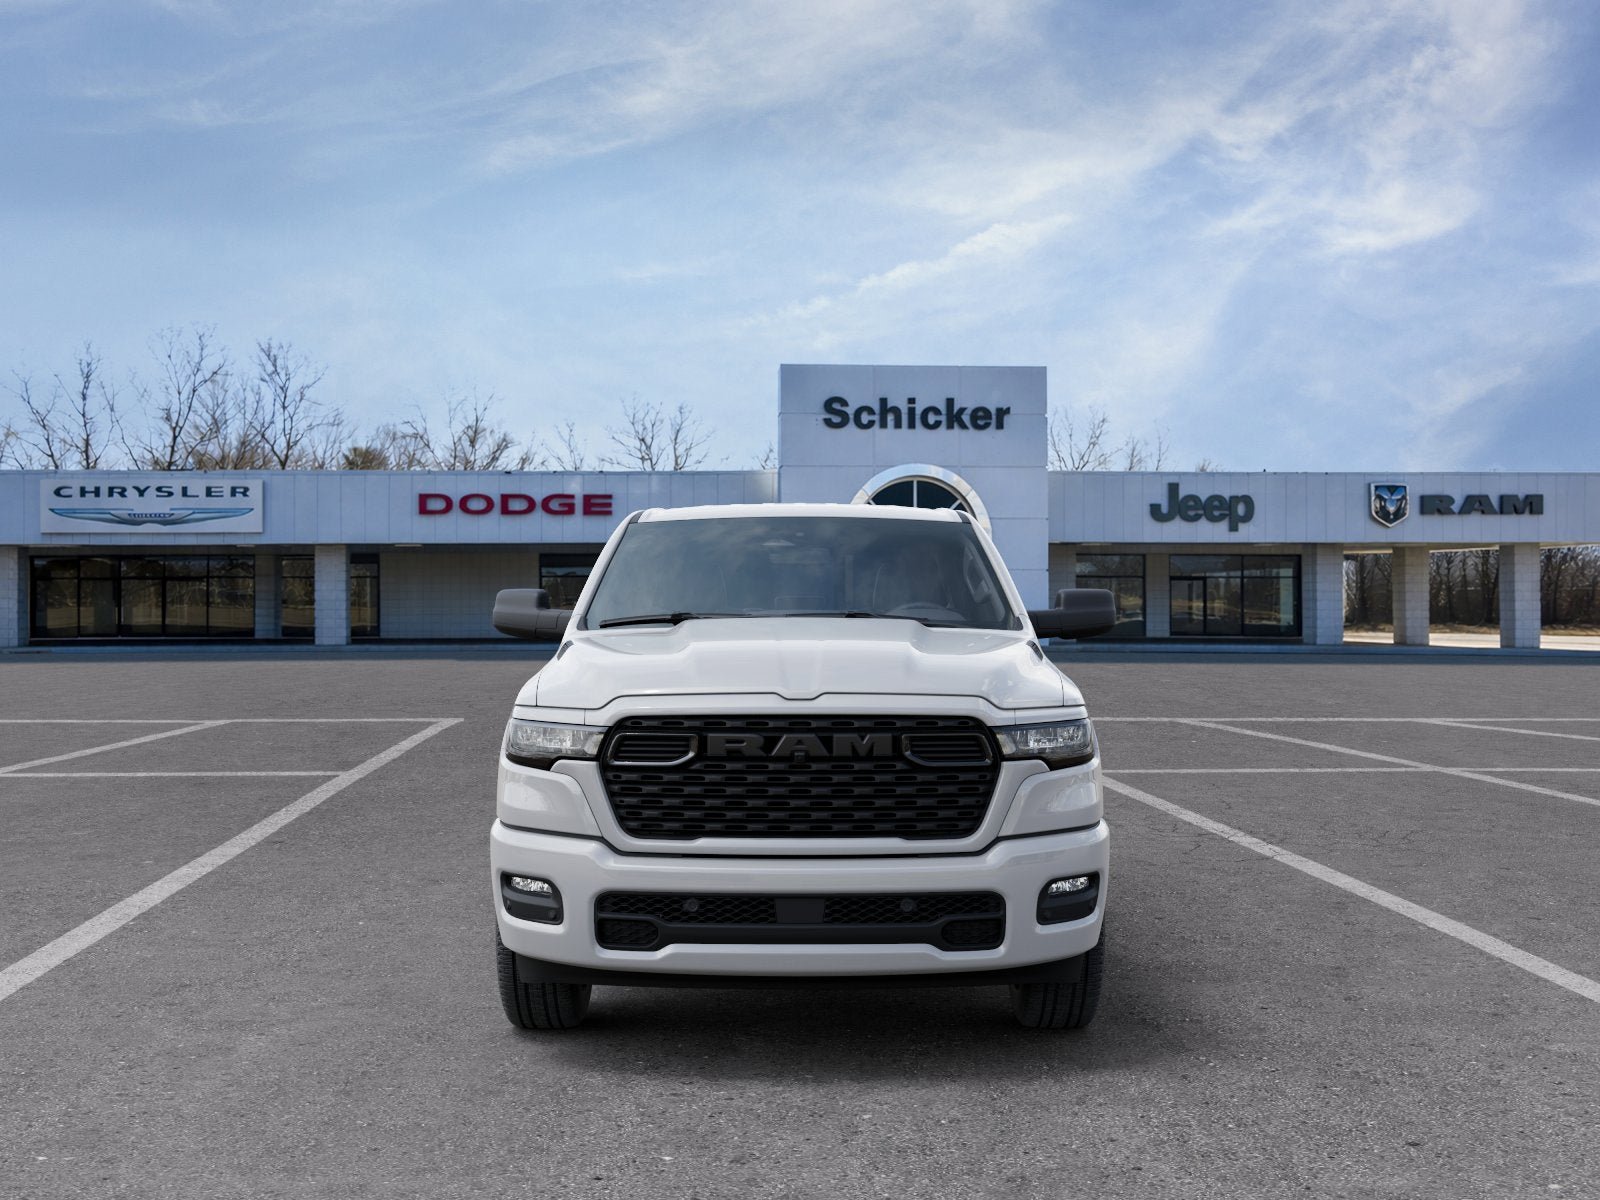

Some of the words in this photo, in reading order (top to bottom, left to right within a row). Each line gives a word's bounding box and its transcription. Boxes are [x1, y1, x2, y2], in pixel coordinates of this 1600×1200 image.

[823, 396, 1011, 430] Schicker
[53, 486, 250, 498] CHRYSLER
[418, 493, 613, 516] DODGE
[1149, 482, 1254, 532] Jeep
[1420, 494, 1544, 516] RAM
[706, 732, 893, 758] RAM
